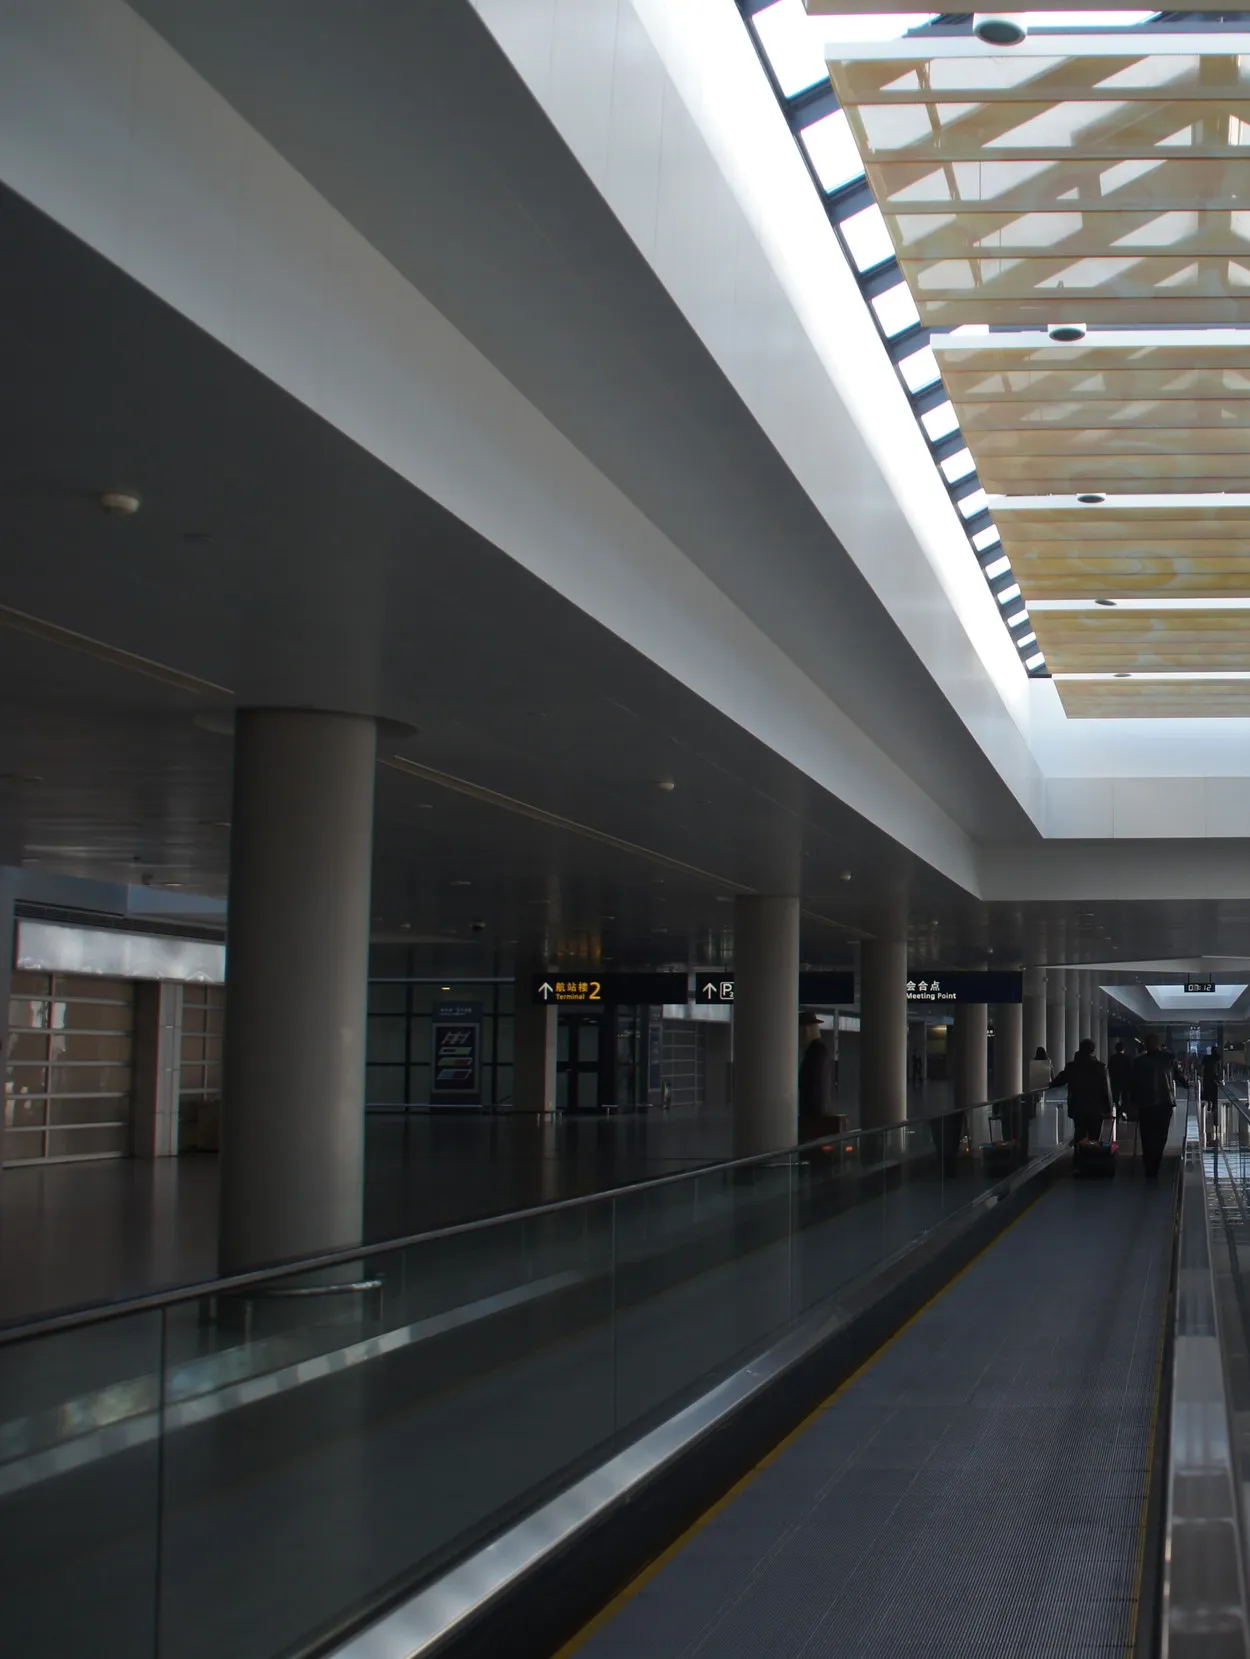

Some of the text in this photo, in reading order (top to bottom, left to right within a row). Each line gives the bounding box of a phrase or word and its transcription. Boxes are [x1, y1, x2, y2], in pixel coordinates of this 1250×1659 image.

[555, 981, 602, 1000] 航站楼 2
[906, 980, 941, 991] 会合点
[906, 992, 957, 1001] Meeting Point
